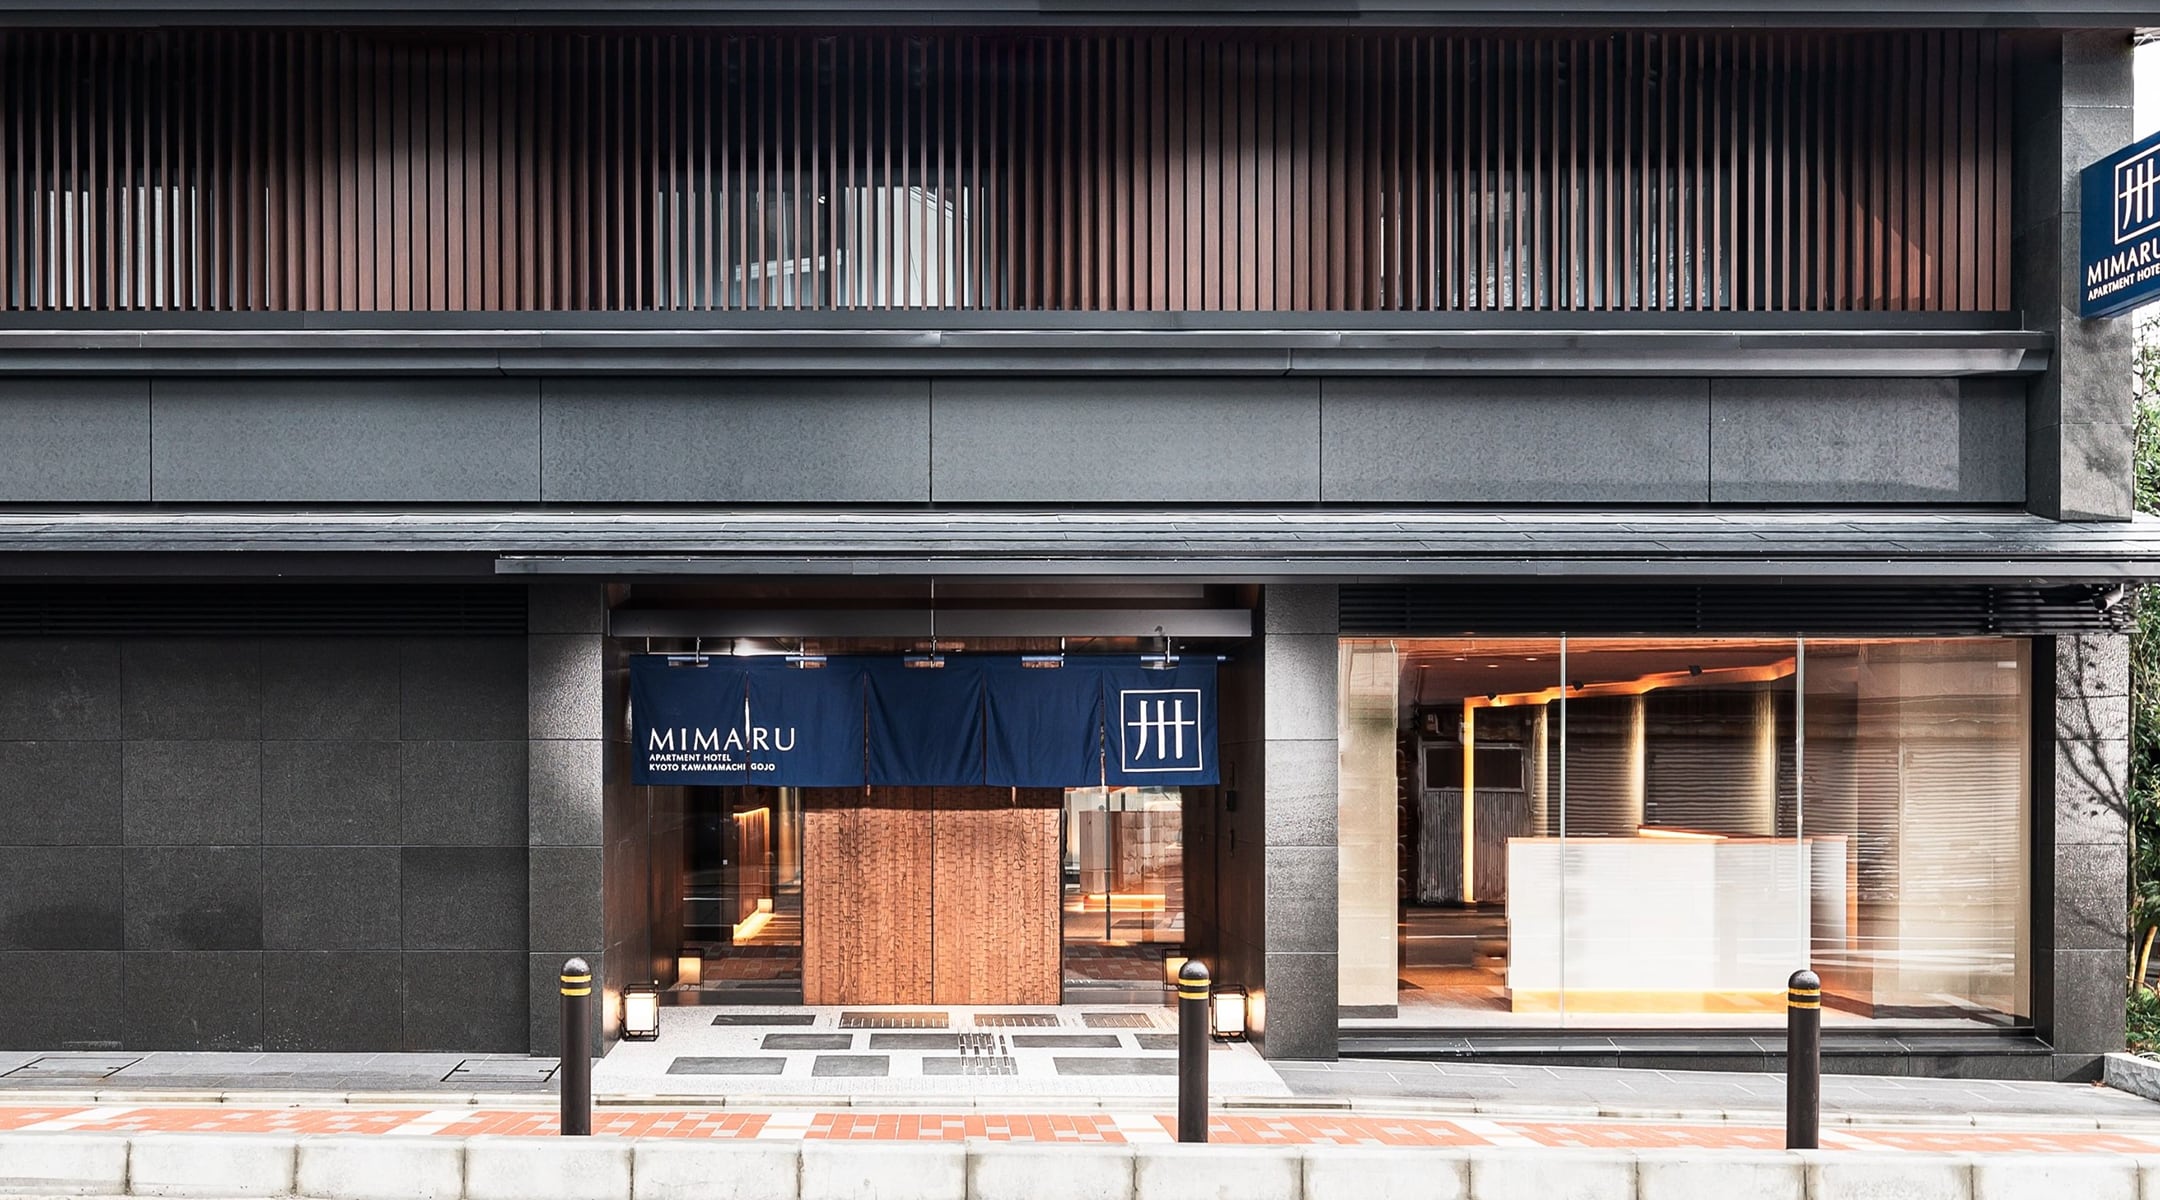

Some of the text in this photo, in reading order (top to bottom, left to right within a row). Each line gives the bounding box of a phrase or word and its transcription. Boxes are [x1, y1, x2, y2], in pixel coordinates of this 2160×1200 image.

[2087, 273, 2135, 302] APARTMENT
[649, 727, 795, 752] MIMARU
[649, 753, 732, 762] APARTMENT HOTEL
[649, 762, 776, 772] KYOTO KAWARAMACHI GOJO
